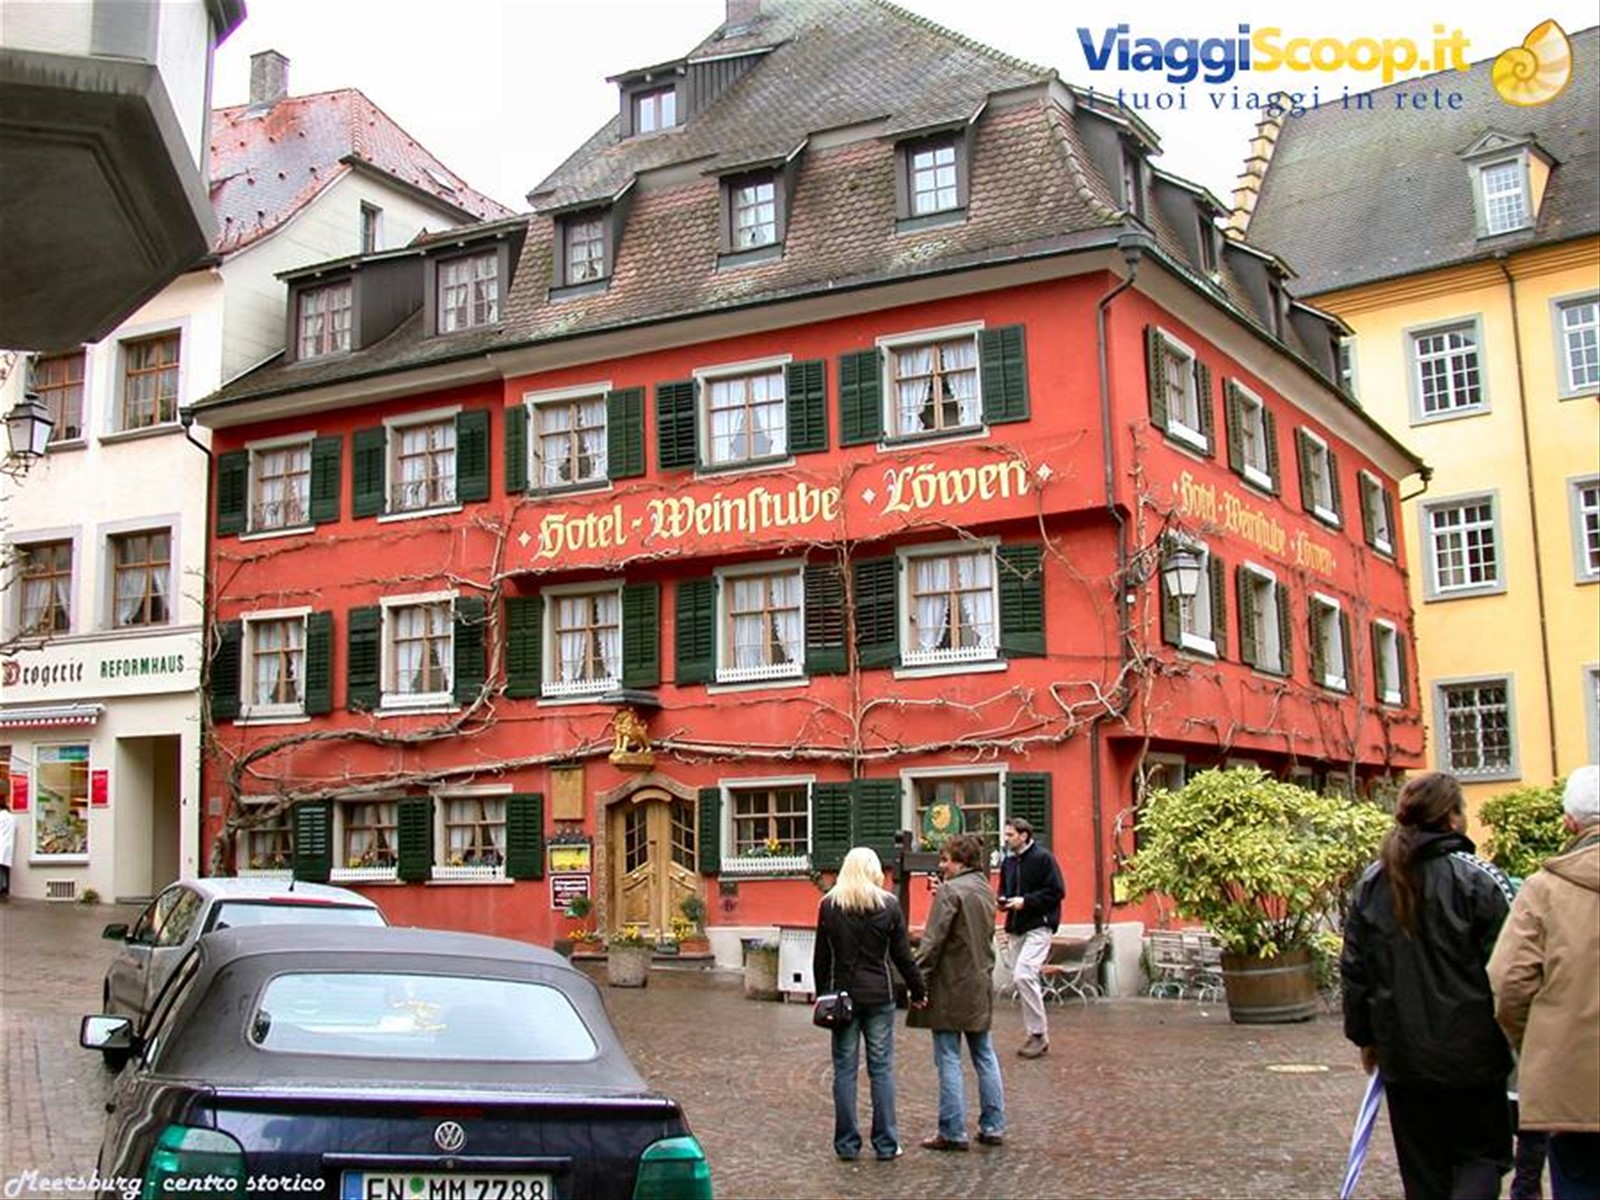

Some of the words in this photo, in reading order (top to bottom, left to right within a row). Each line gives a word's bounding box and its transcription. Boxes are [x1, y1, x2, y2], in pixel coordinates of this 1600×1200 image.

[532, 505, 626, 561] Hotel
[880, 459, 1030, 517] Löwen
[2, 658, 83, 687] Drogerie
[100, 654, 184, 678] REFORMHAUS
[428, 1179, 466, 1200] MM
